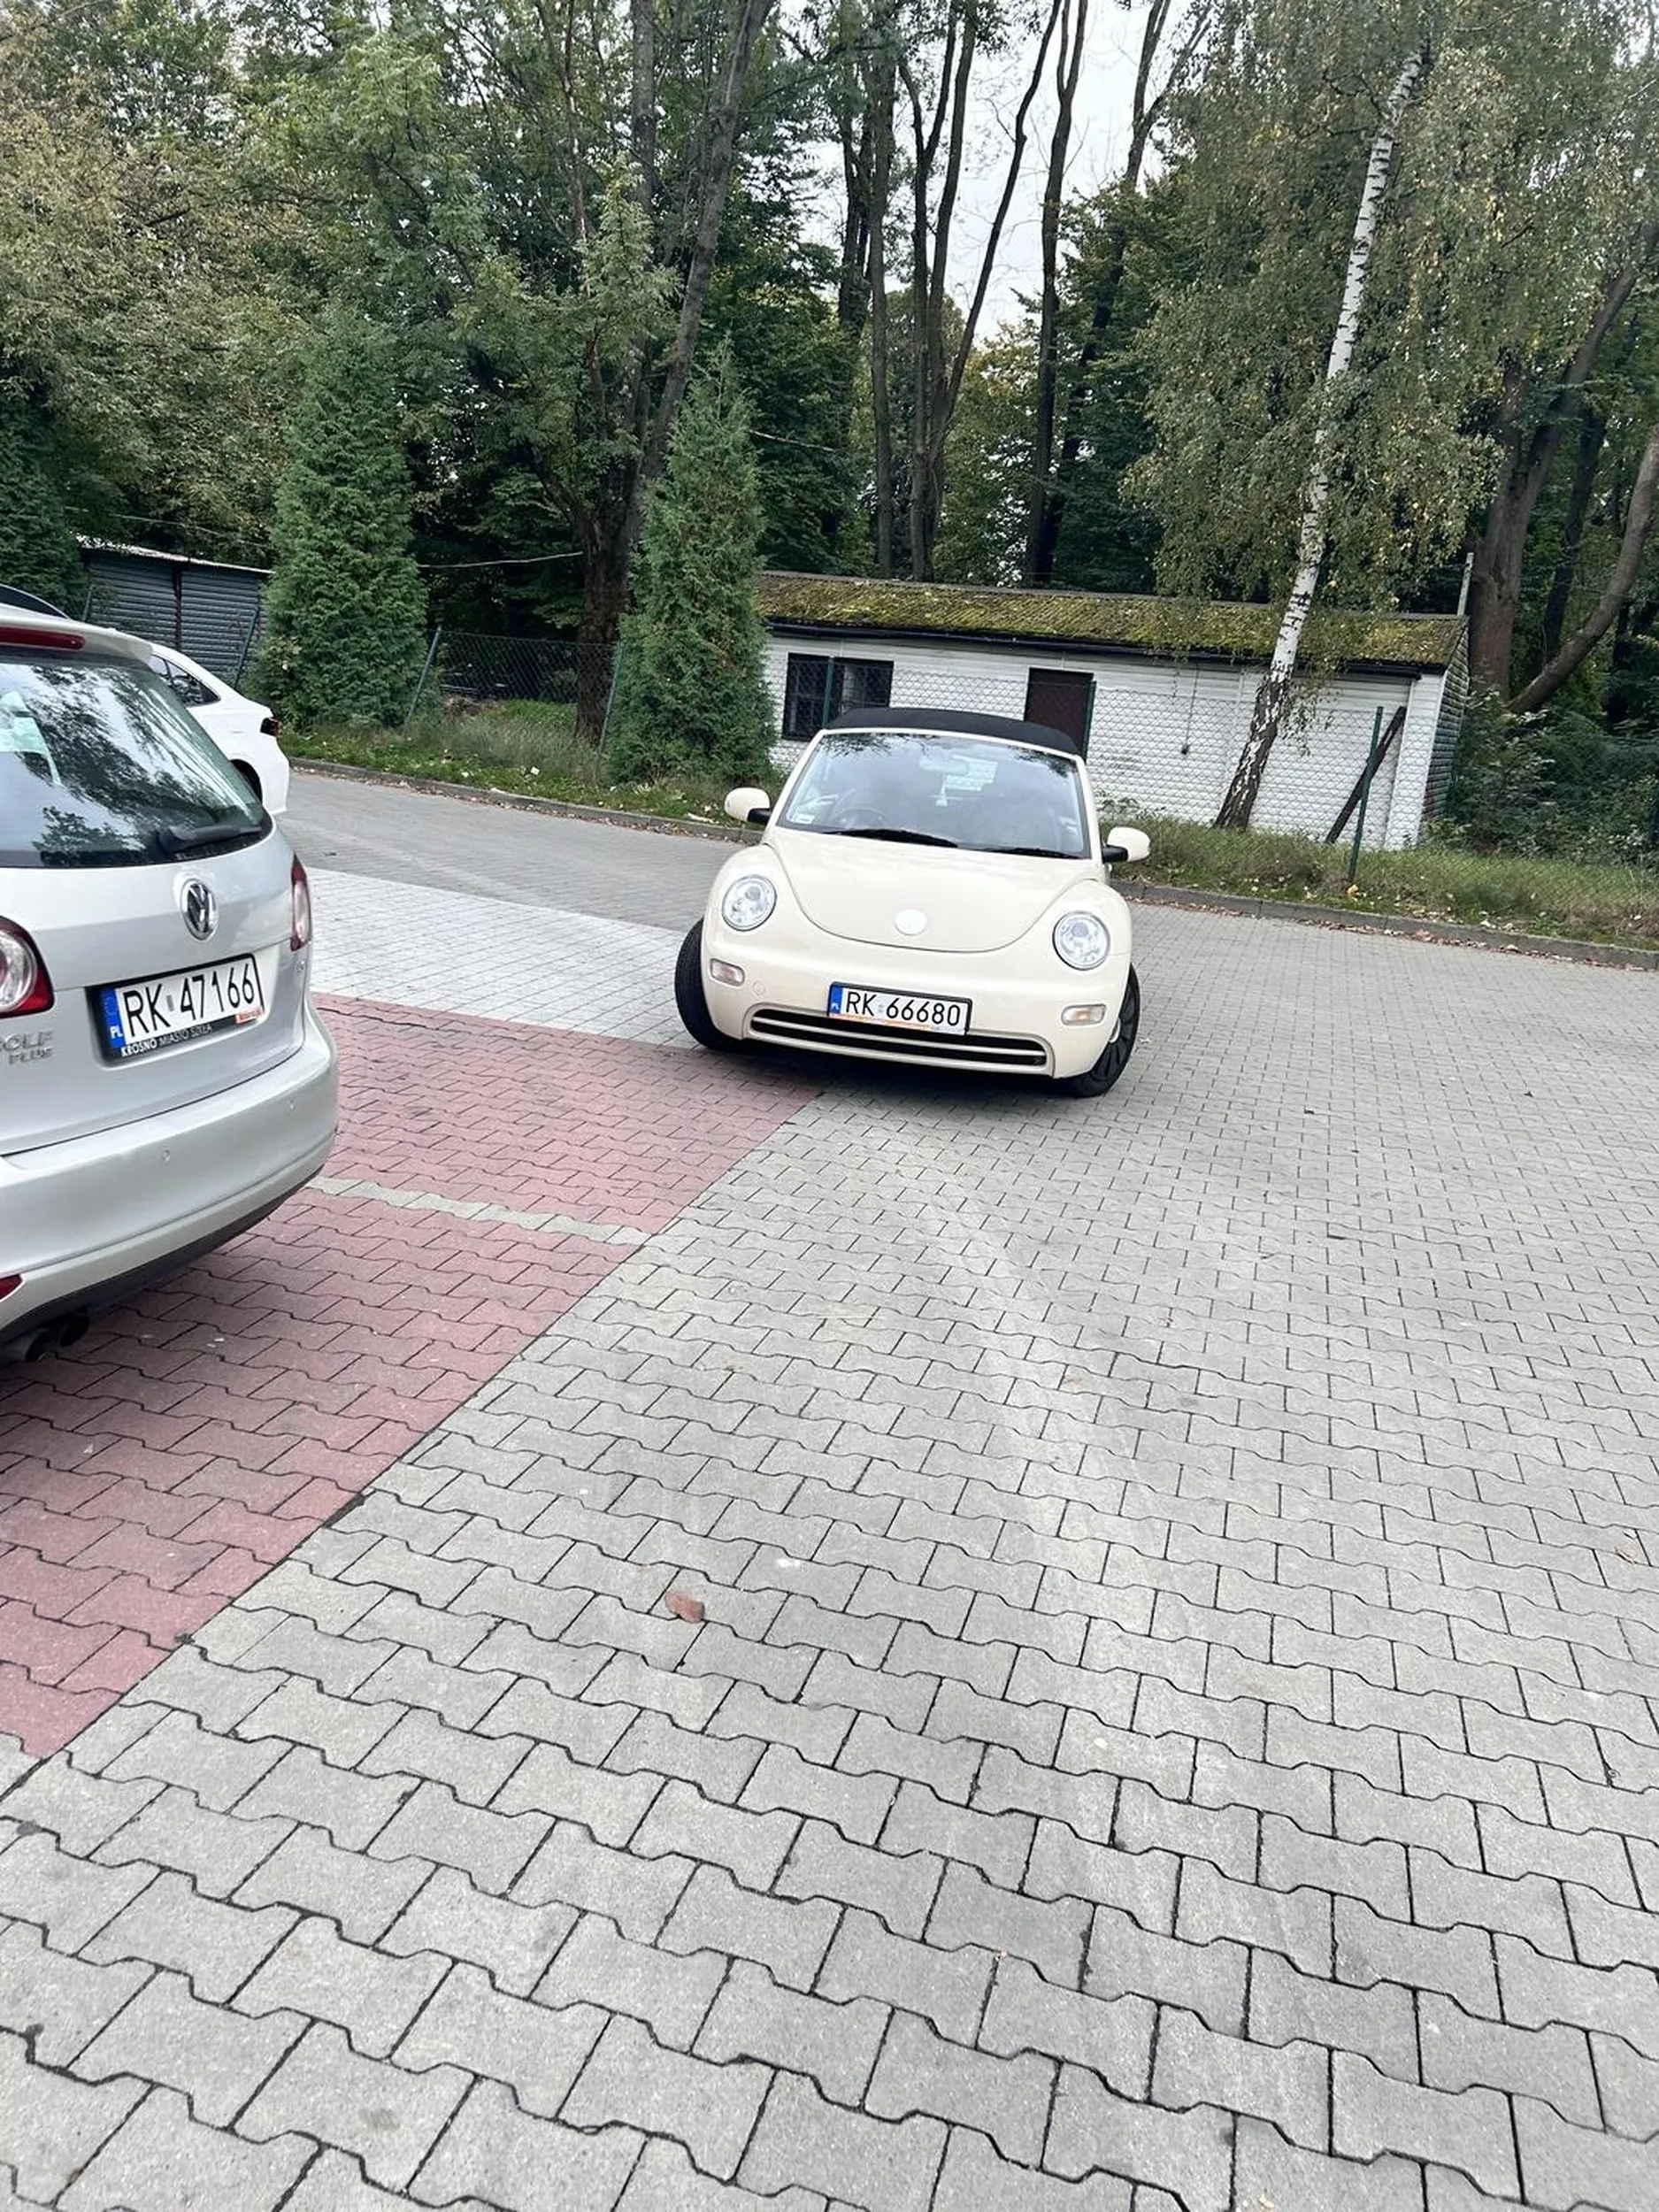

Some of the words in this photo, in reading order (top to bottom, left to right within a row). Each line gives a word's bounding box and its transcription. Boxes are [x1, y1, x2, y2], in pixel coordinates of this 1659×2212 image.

[123, 983, 171, 1037] RK
[180, 964, 254, 1020] 47166
[846, 991, 877, 1017] RK
[886, 998, 961, 1026] 66680
[0, 1030, 56, 1052] OLF
[110, 1025, 123, 1039] PL
[121, 1038, 157, 1057] KROSNO
[159, 1029, 189, 1046] MIASTO
